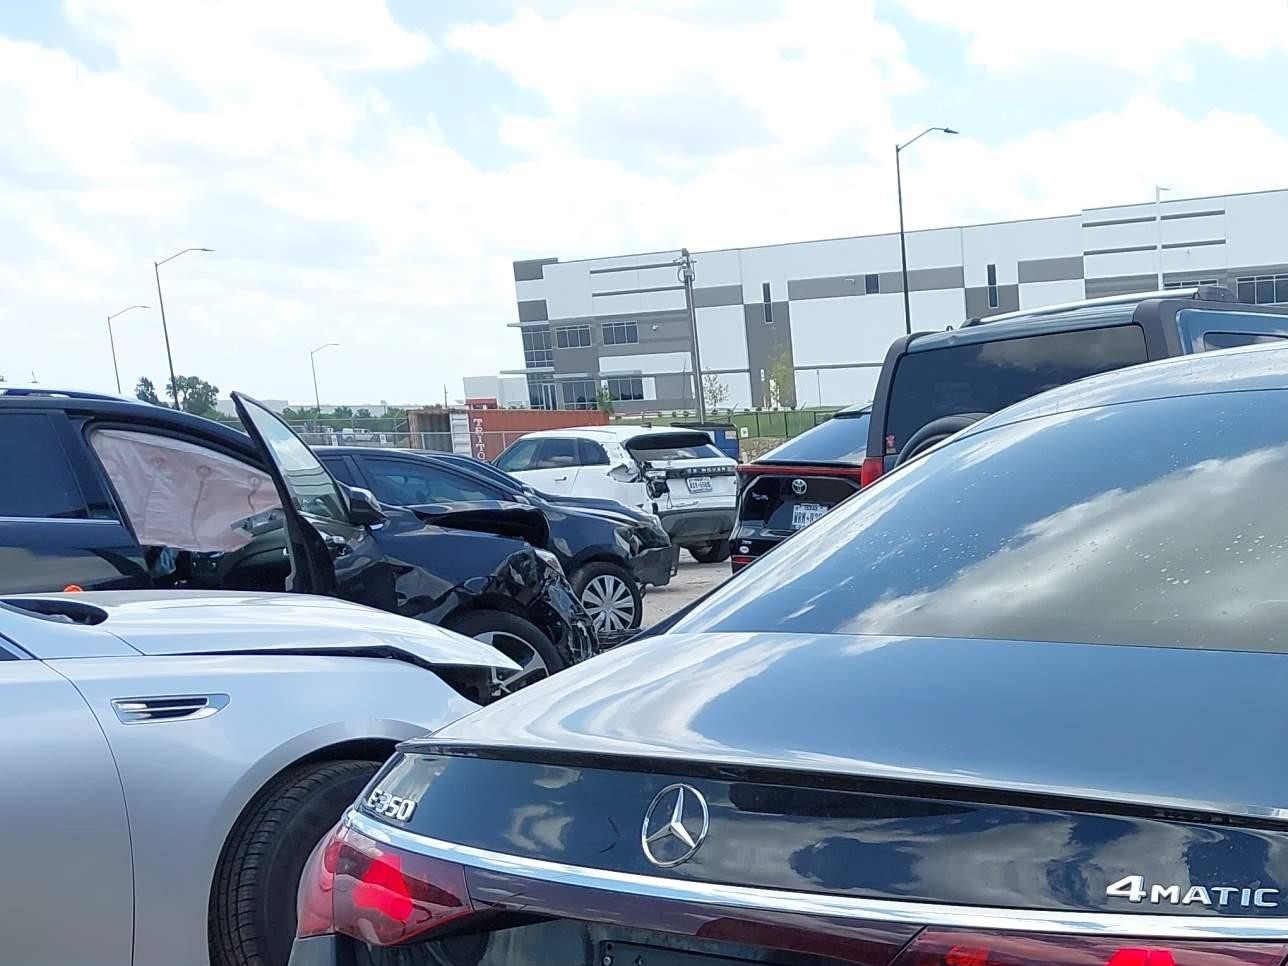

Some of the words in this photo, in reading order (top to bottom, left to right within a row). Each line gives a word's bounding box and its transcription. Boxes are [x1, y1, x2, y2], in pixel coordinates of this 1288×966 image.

[473, 418, 487, 462] TRITO
[367, 788, 416, 821] E350
[1106, 875, 1280, 907] 4MATIC
